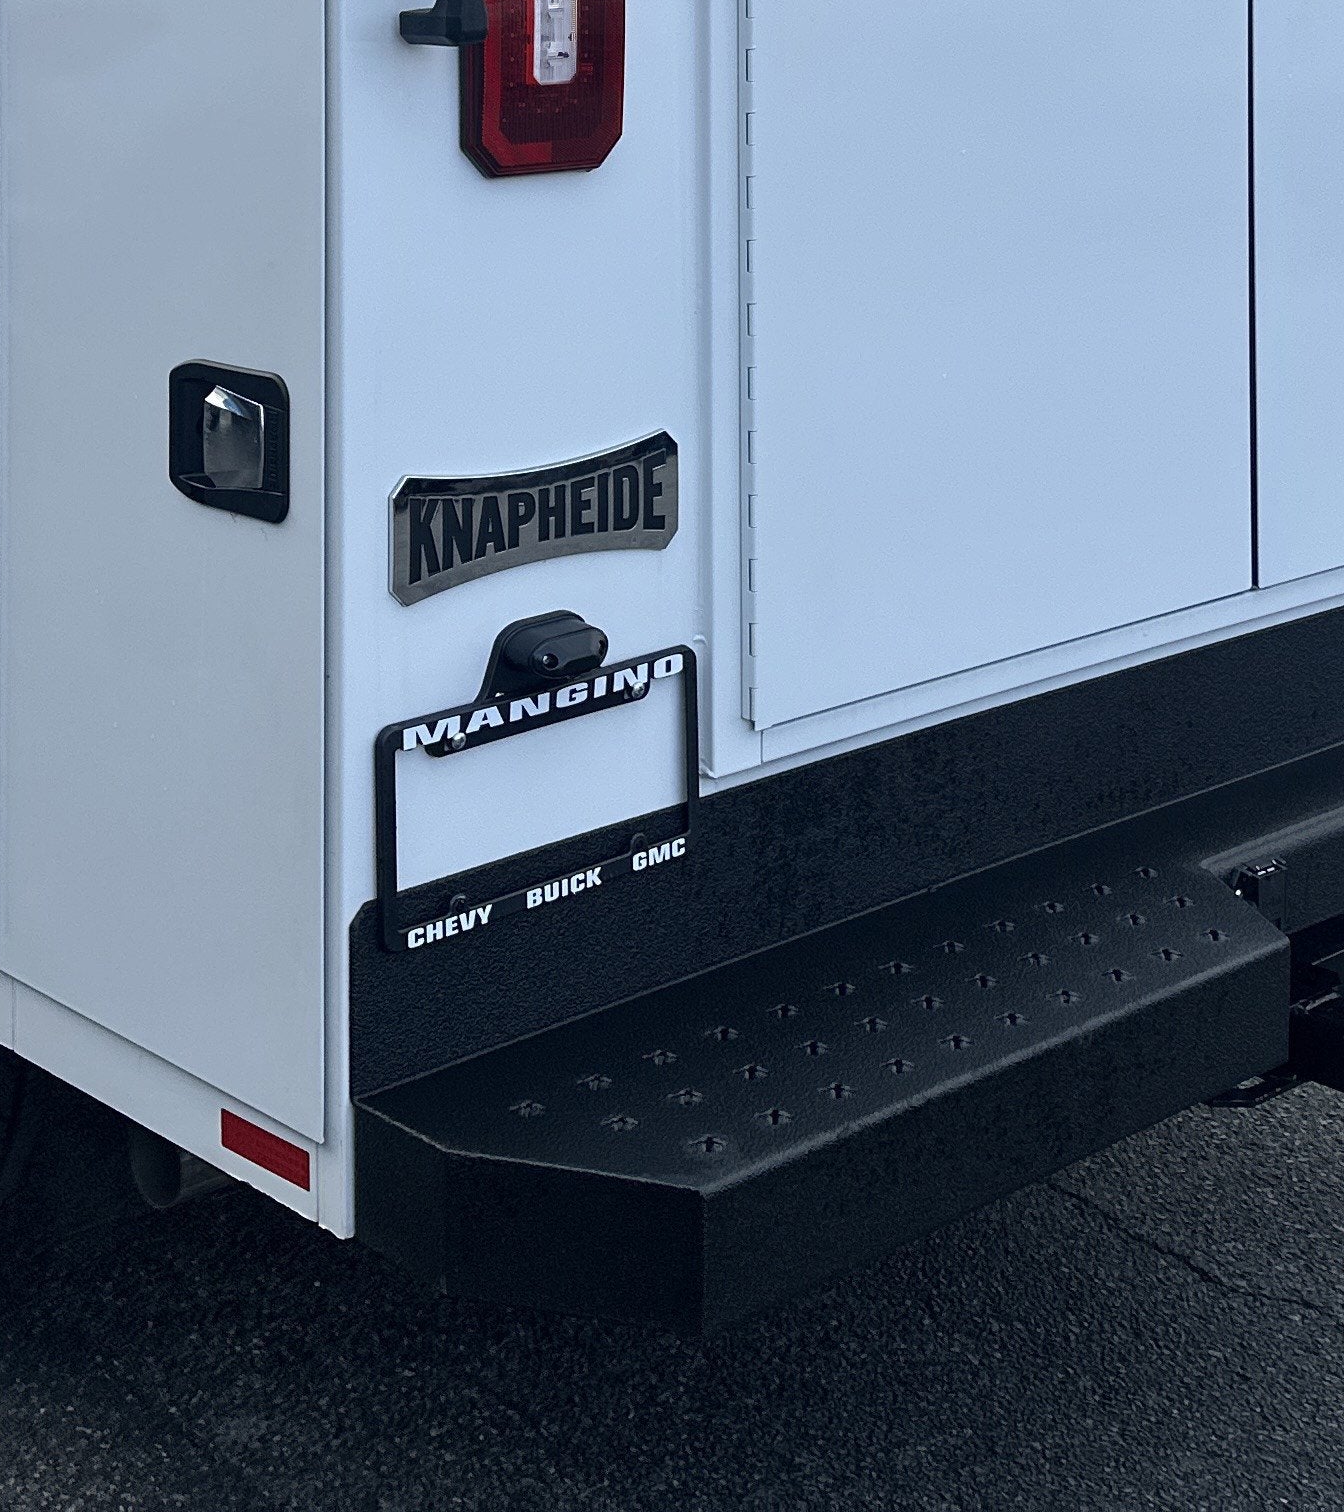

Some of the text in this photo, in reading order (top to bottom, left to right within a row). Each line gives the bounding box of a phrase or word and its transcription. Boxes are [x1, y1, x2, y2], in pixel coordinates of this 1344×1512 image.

[408, 448, 667, 585] KNAPHEIDE
[402, 652, 685, 751] MANGINO
[407, 837, 686, 949] CHEVY BUICK GMC
